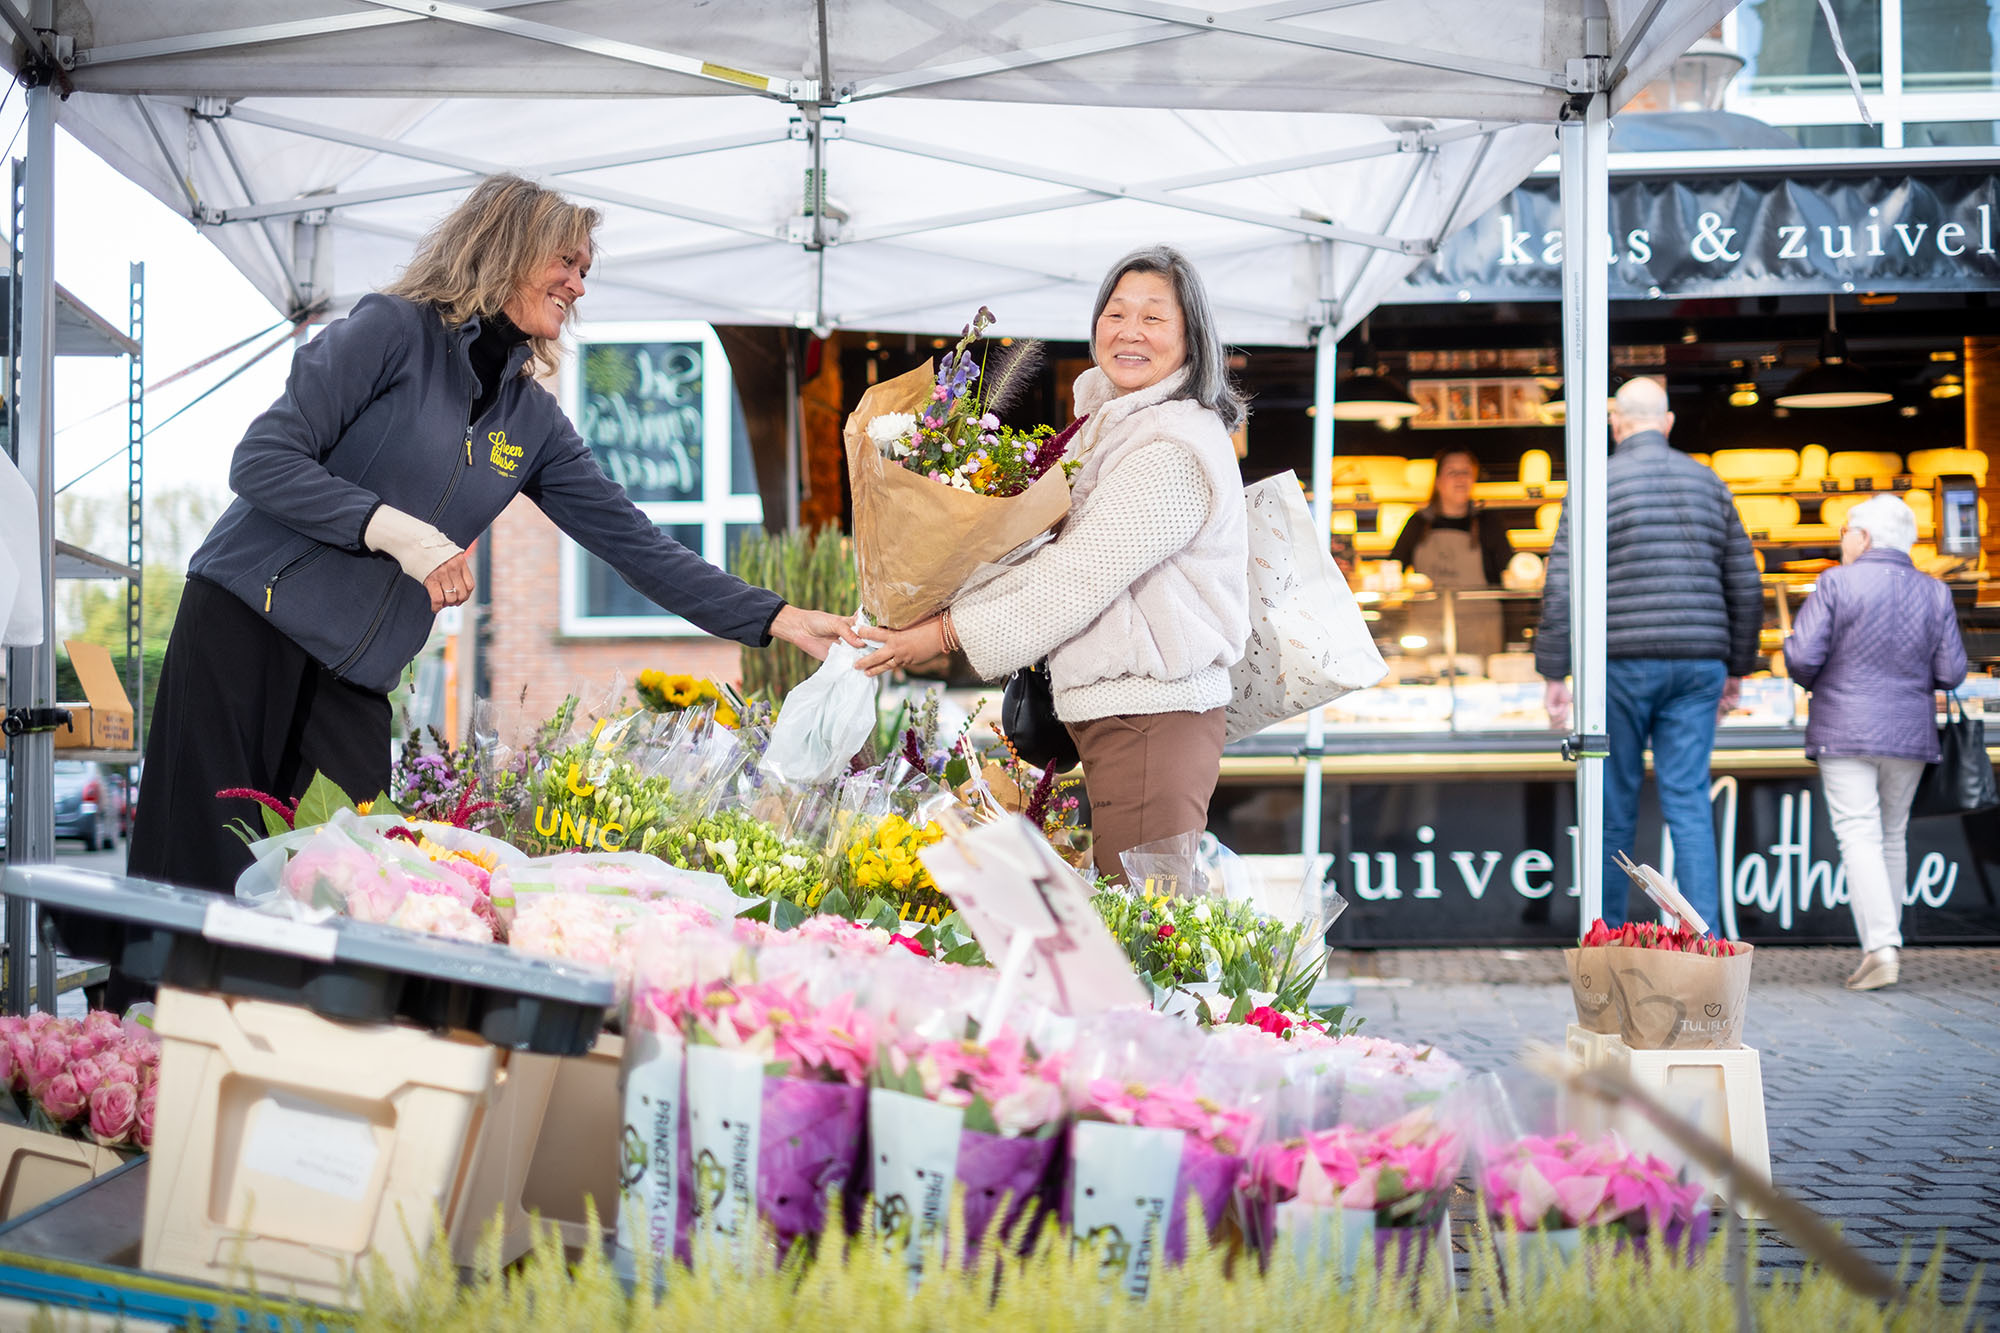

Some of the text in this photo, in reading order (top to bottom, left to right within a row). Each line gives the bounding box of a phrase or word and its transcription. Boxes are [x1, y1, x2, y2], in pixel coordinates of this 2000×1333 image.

[1690, 211, 1742, 264] &
[1778, 204, 1998, 261] zuivel
[1146, 873, 1178, 881] UNICUM
